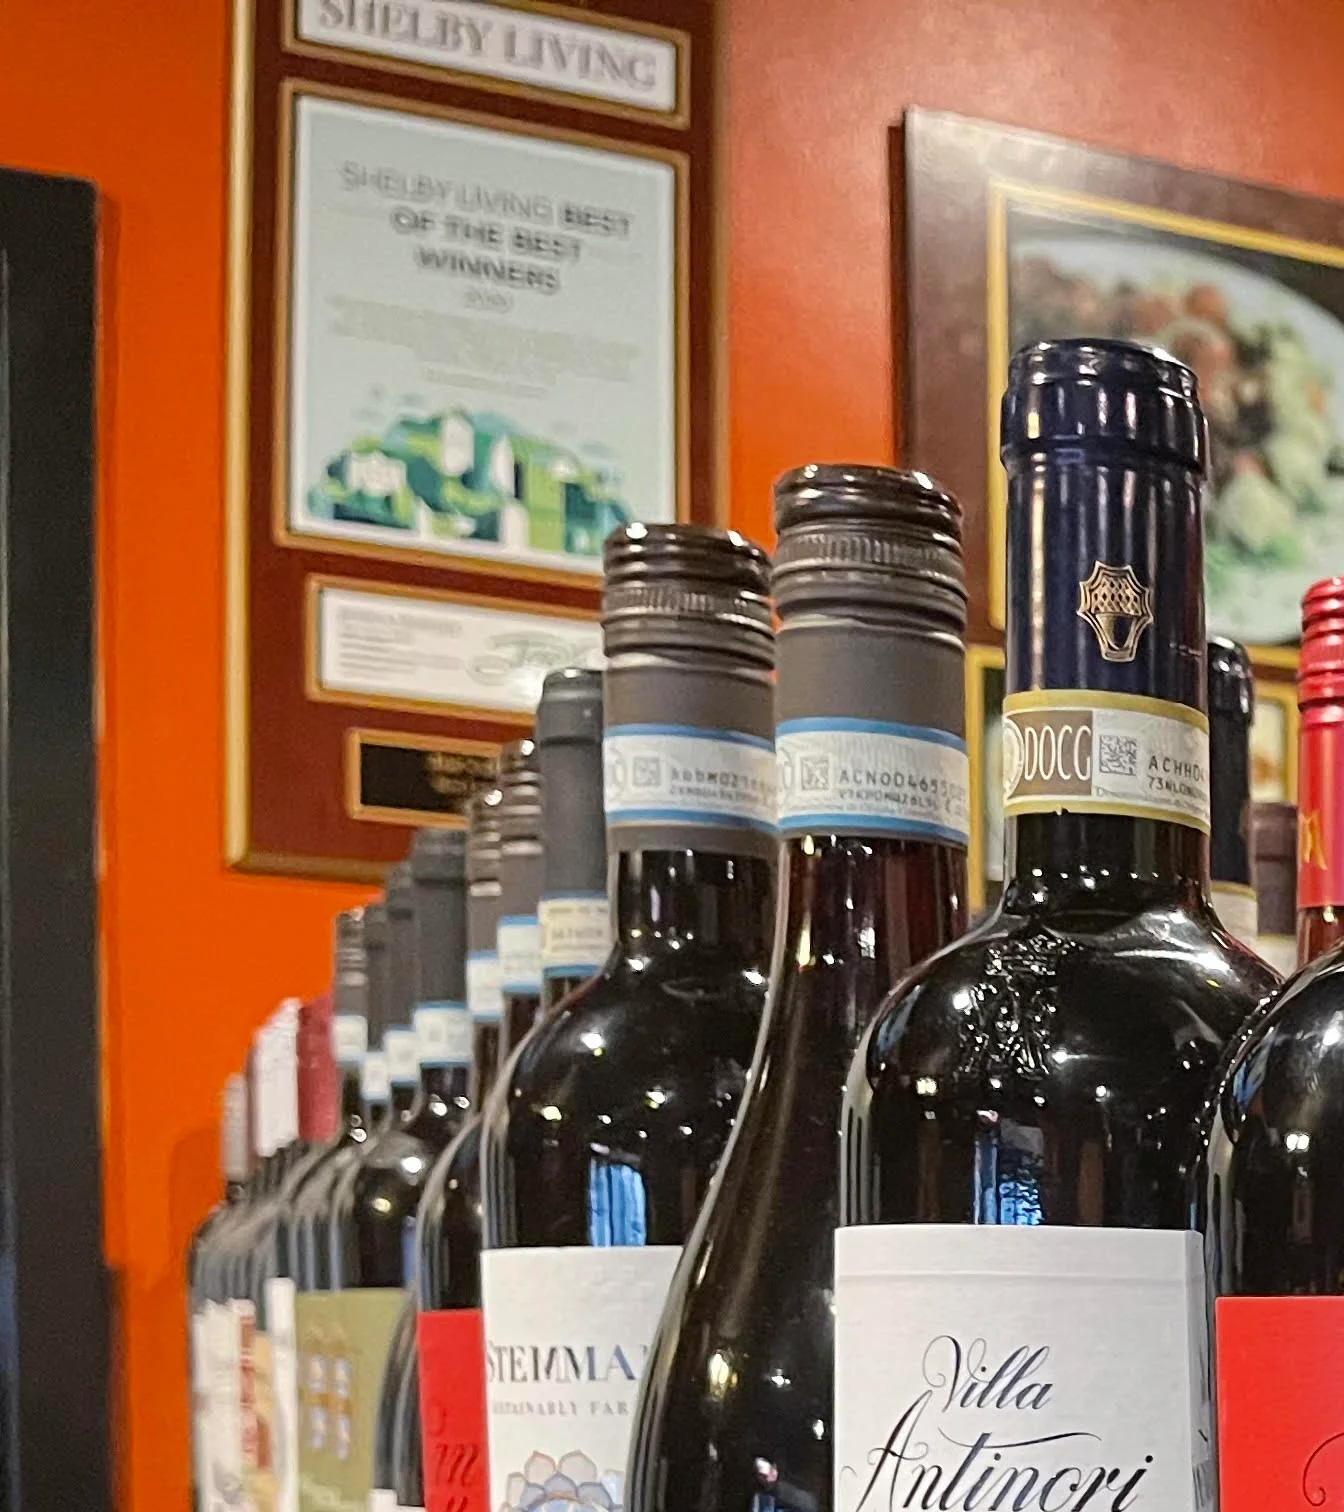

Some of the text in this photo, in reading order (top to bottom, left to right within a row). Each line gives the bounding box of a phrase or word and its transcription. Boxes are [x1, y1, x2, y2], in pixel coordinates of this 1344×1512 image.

[503, 24, 657, 90] LIVING
[390, 206, 434, 235] OF
[443, 214, 506, 247] THE
[562, 203, 634, 237] BEST
[416, 247, 560, 294] WINNERS
[1024, 724, 1092, 781] DOCG
[922, 1335, 1054, 1413] Villa
